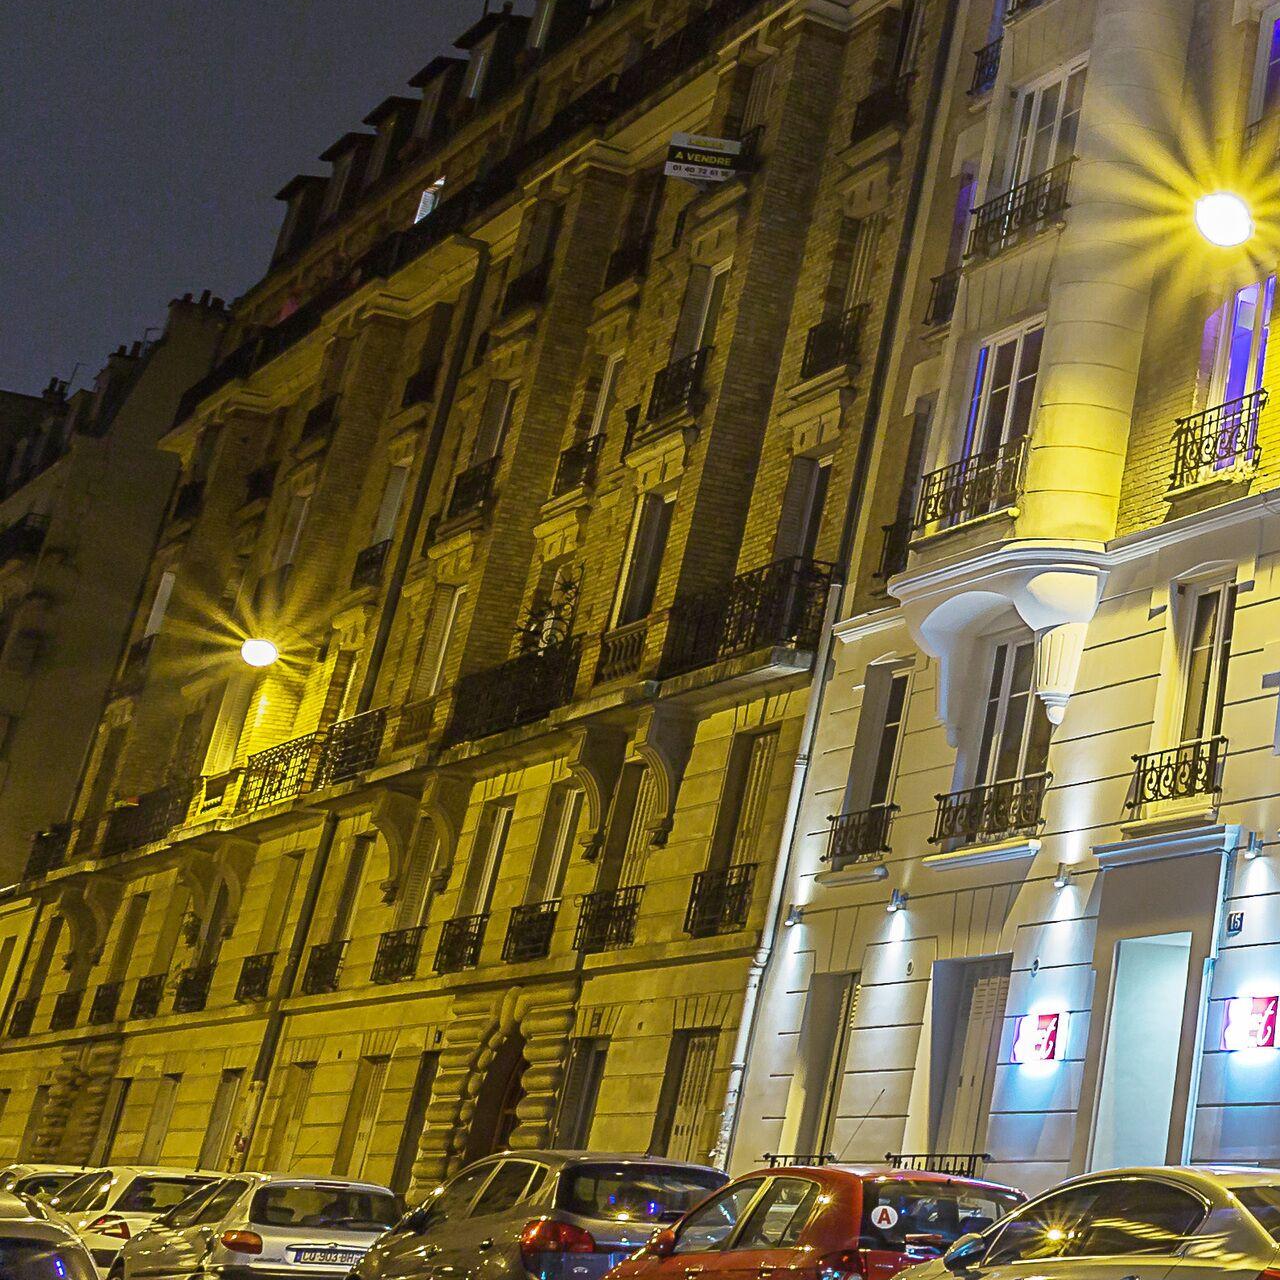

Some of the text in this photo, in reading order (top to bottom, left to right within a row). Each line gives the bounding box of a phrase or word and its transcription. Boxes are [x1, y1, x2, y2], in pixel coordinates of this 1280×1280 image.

[687, 152, 732, 166] VENDRE
[1230, 912, 1241, 930] 15
[876, 1207, 892, 1225] A
